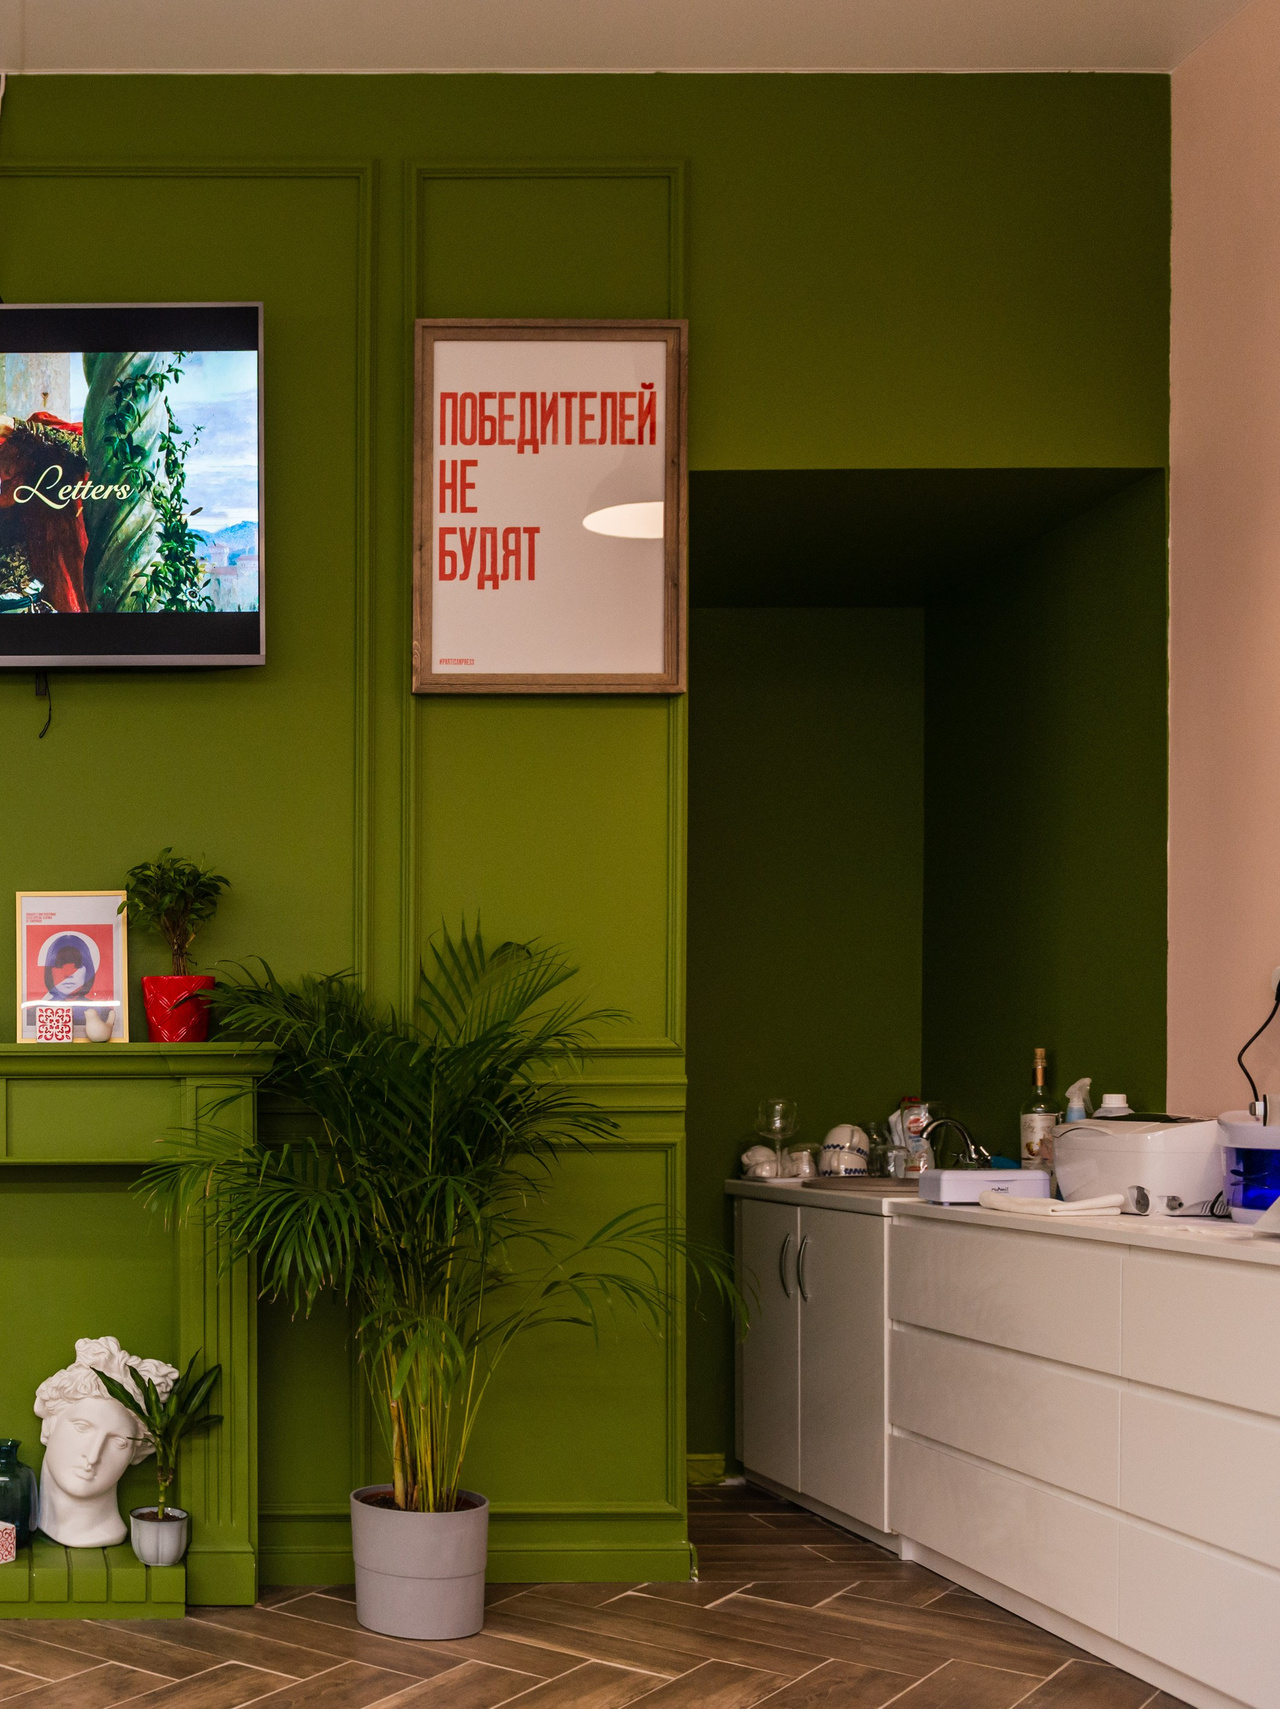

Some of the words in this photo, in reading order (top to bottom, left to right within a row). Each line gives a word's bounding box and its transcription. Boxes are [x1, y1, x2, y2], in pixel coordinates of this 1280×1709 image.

[439, 382, 657, 454] ПОБЕДИТЕЛЕЙ
[13, 464, 135, 510] Letters
[439, 460, 478, 513] НЕ
[438, 526, 540, 590] БУДЯТ
